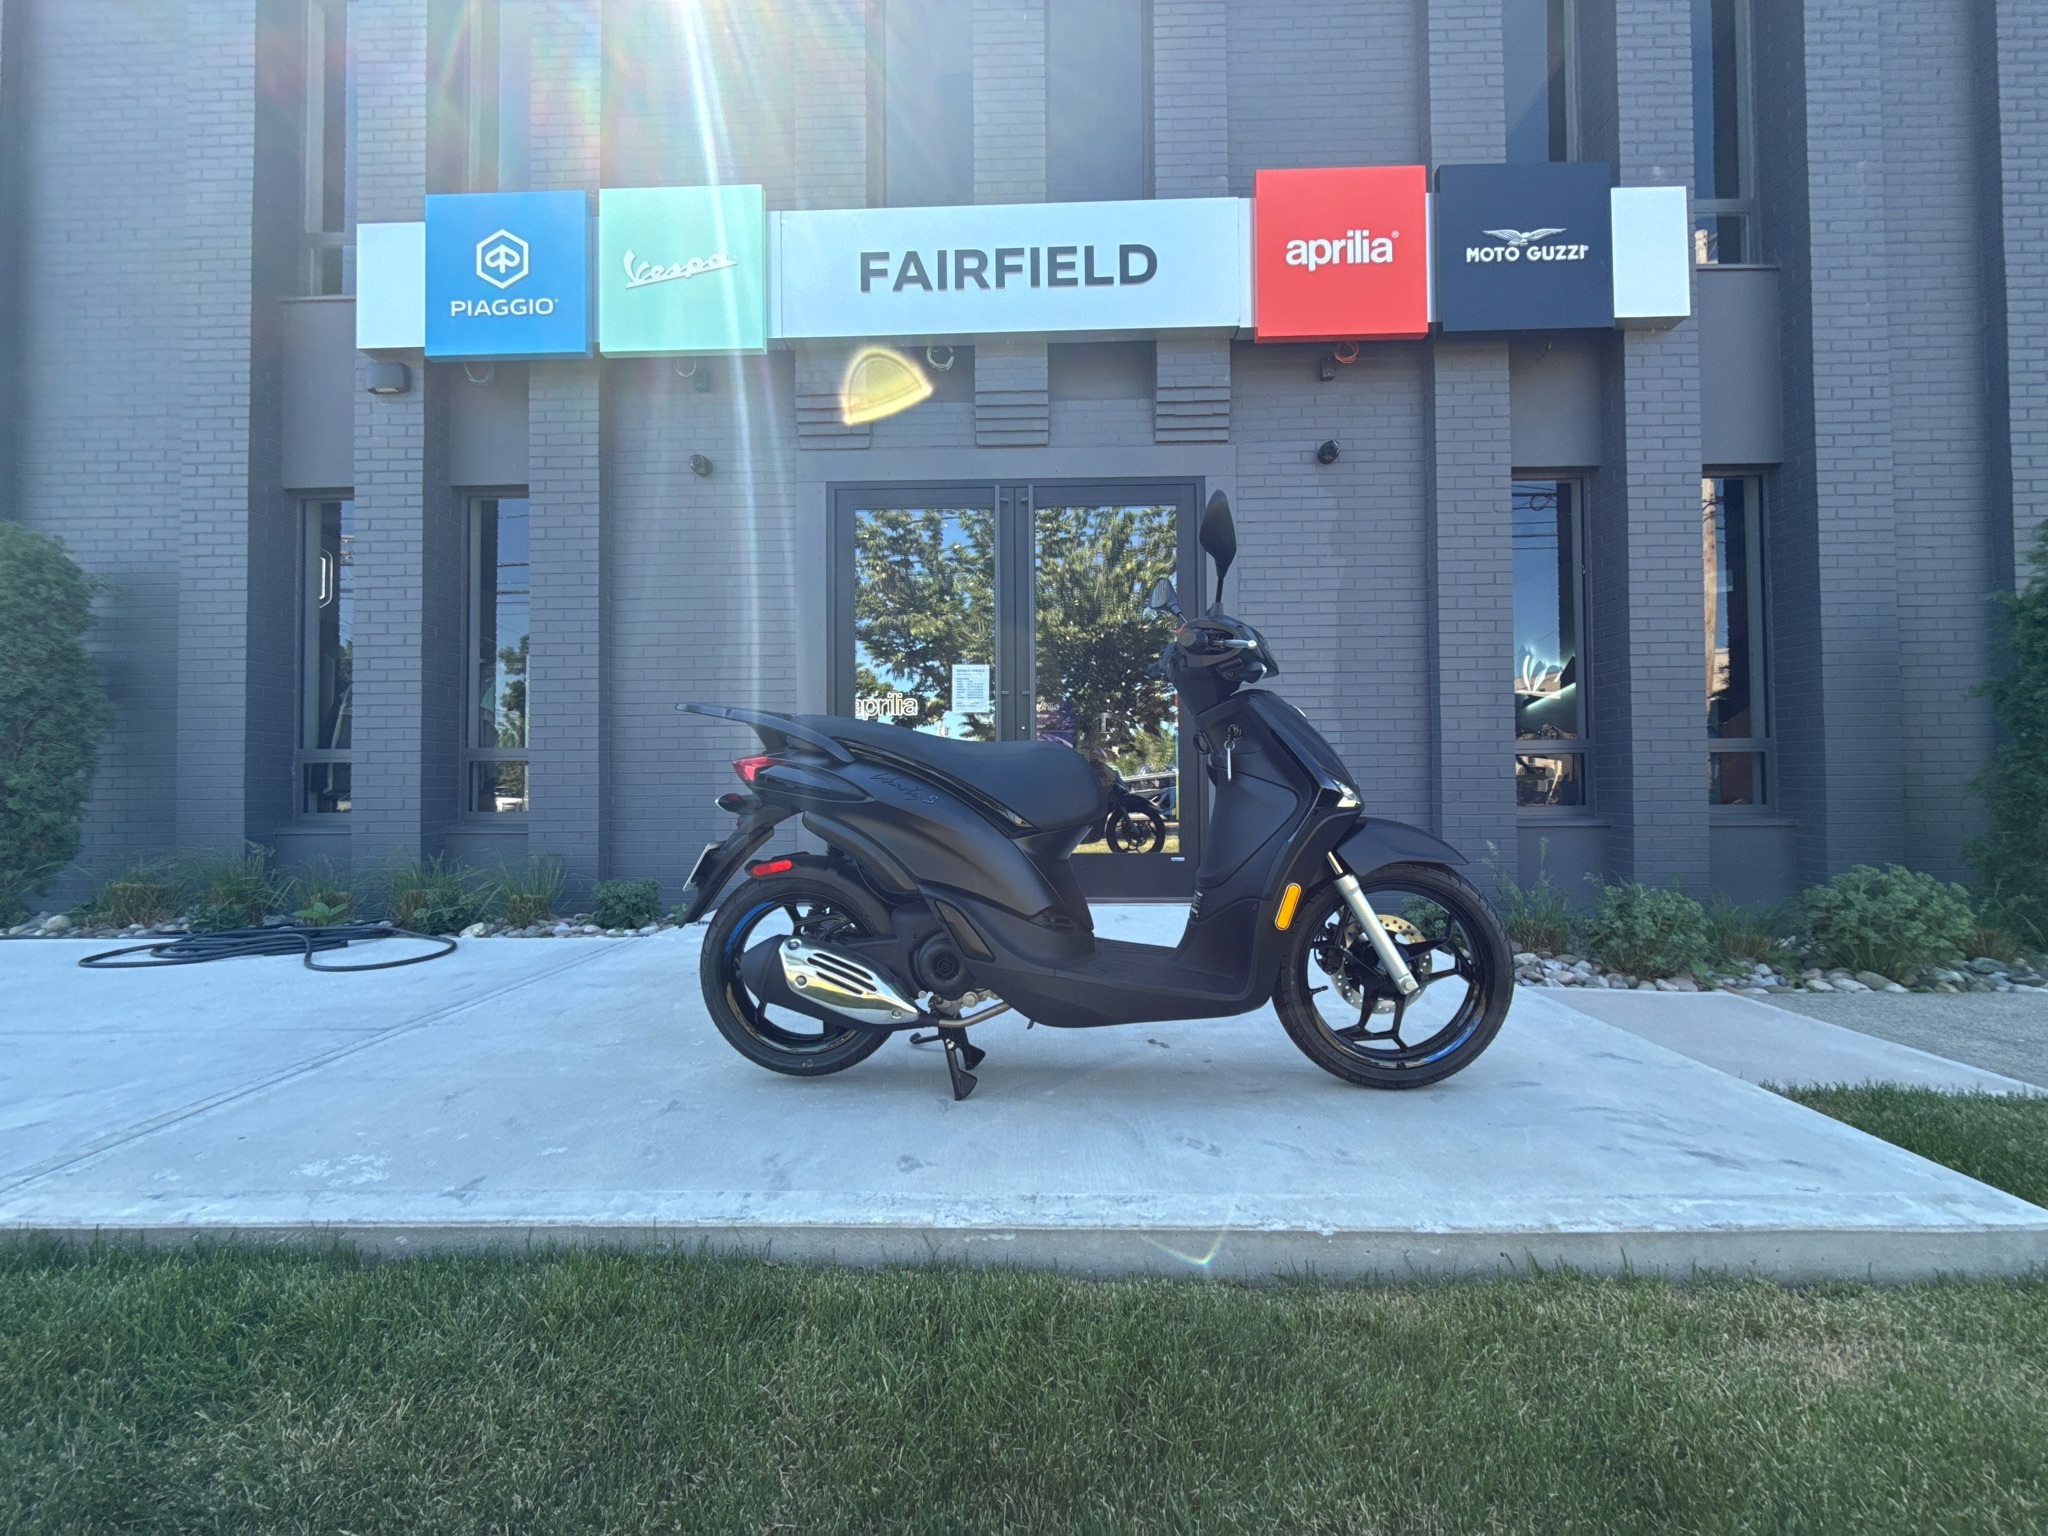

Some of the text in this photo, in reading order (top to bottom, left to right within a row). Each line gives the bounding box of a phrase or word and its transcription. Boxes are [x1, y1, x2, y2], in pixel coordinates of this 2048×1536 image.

[623, 248, 738, 289] Vespa
[860, 243, 1158, 293] FAIRFIELD
[1285, 229, 1393, 271] aprilia
[1466, 244, 1585, 263] MOTO GUZZI
[450, 297, 554, 317] PIAGGIO
